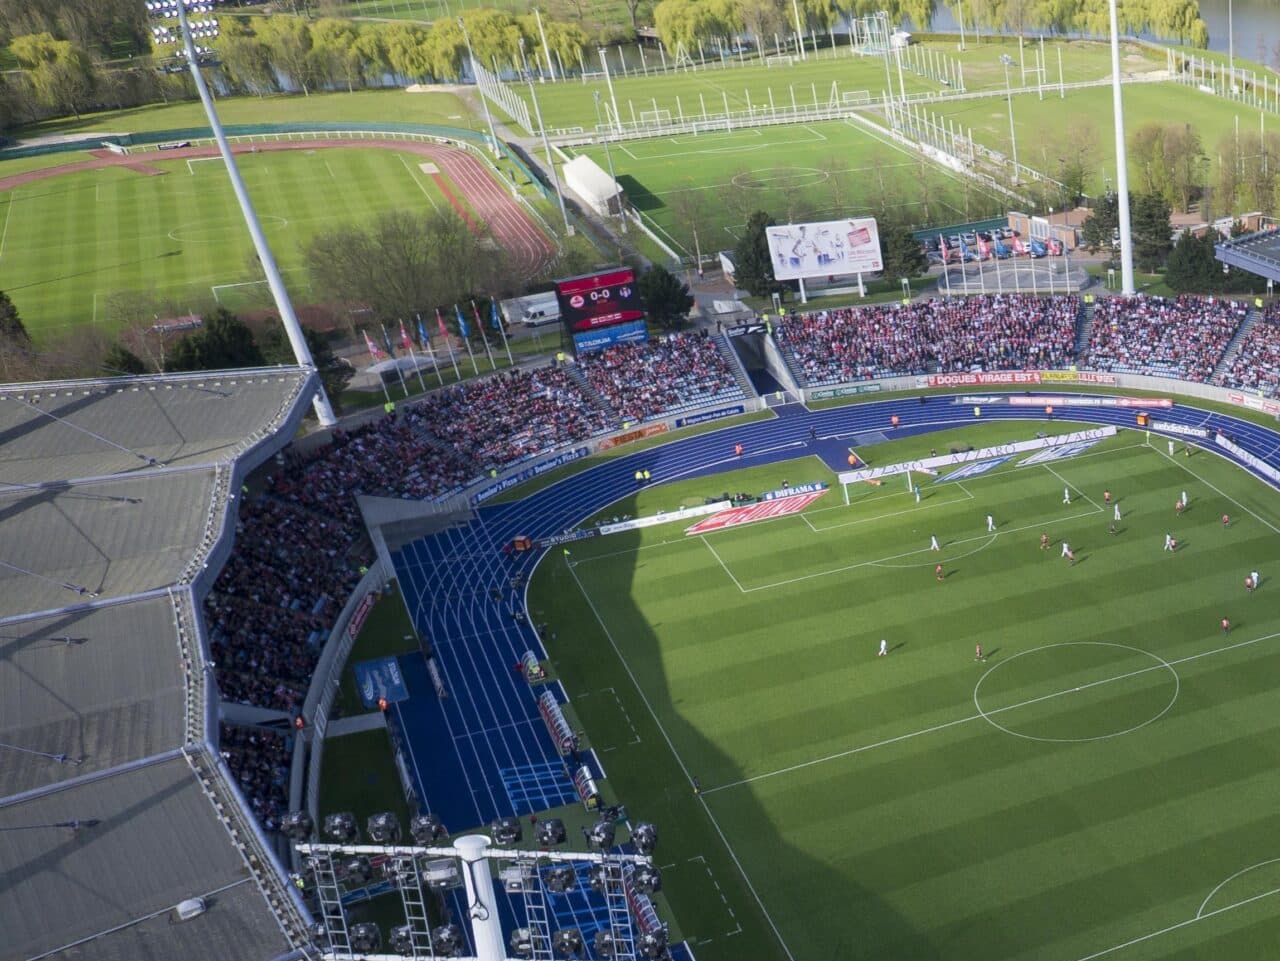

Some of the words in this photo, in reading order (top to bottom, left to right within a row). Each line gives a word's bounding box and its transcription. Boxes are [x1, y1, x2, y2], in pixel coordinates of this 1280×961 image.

[937, 374, 977, 385] DOGUES
[979, 373, 1013, 384] VIRAGE
[1015, 372, 1033, 382] EST
[1152, 421, 1207, 438] webdistrib.com
[1043, 430, 1104, 447] AZZARO
[951, 444, 1015, 464] AZZARO
[856, 463, 923, 481] AZZARO
[774, 483, 814, 498] DIFRAMA
